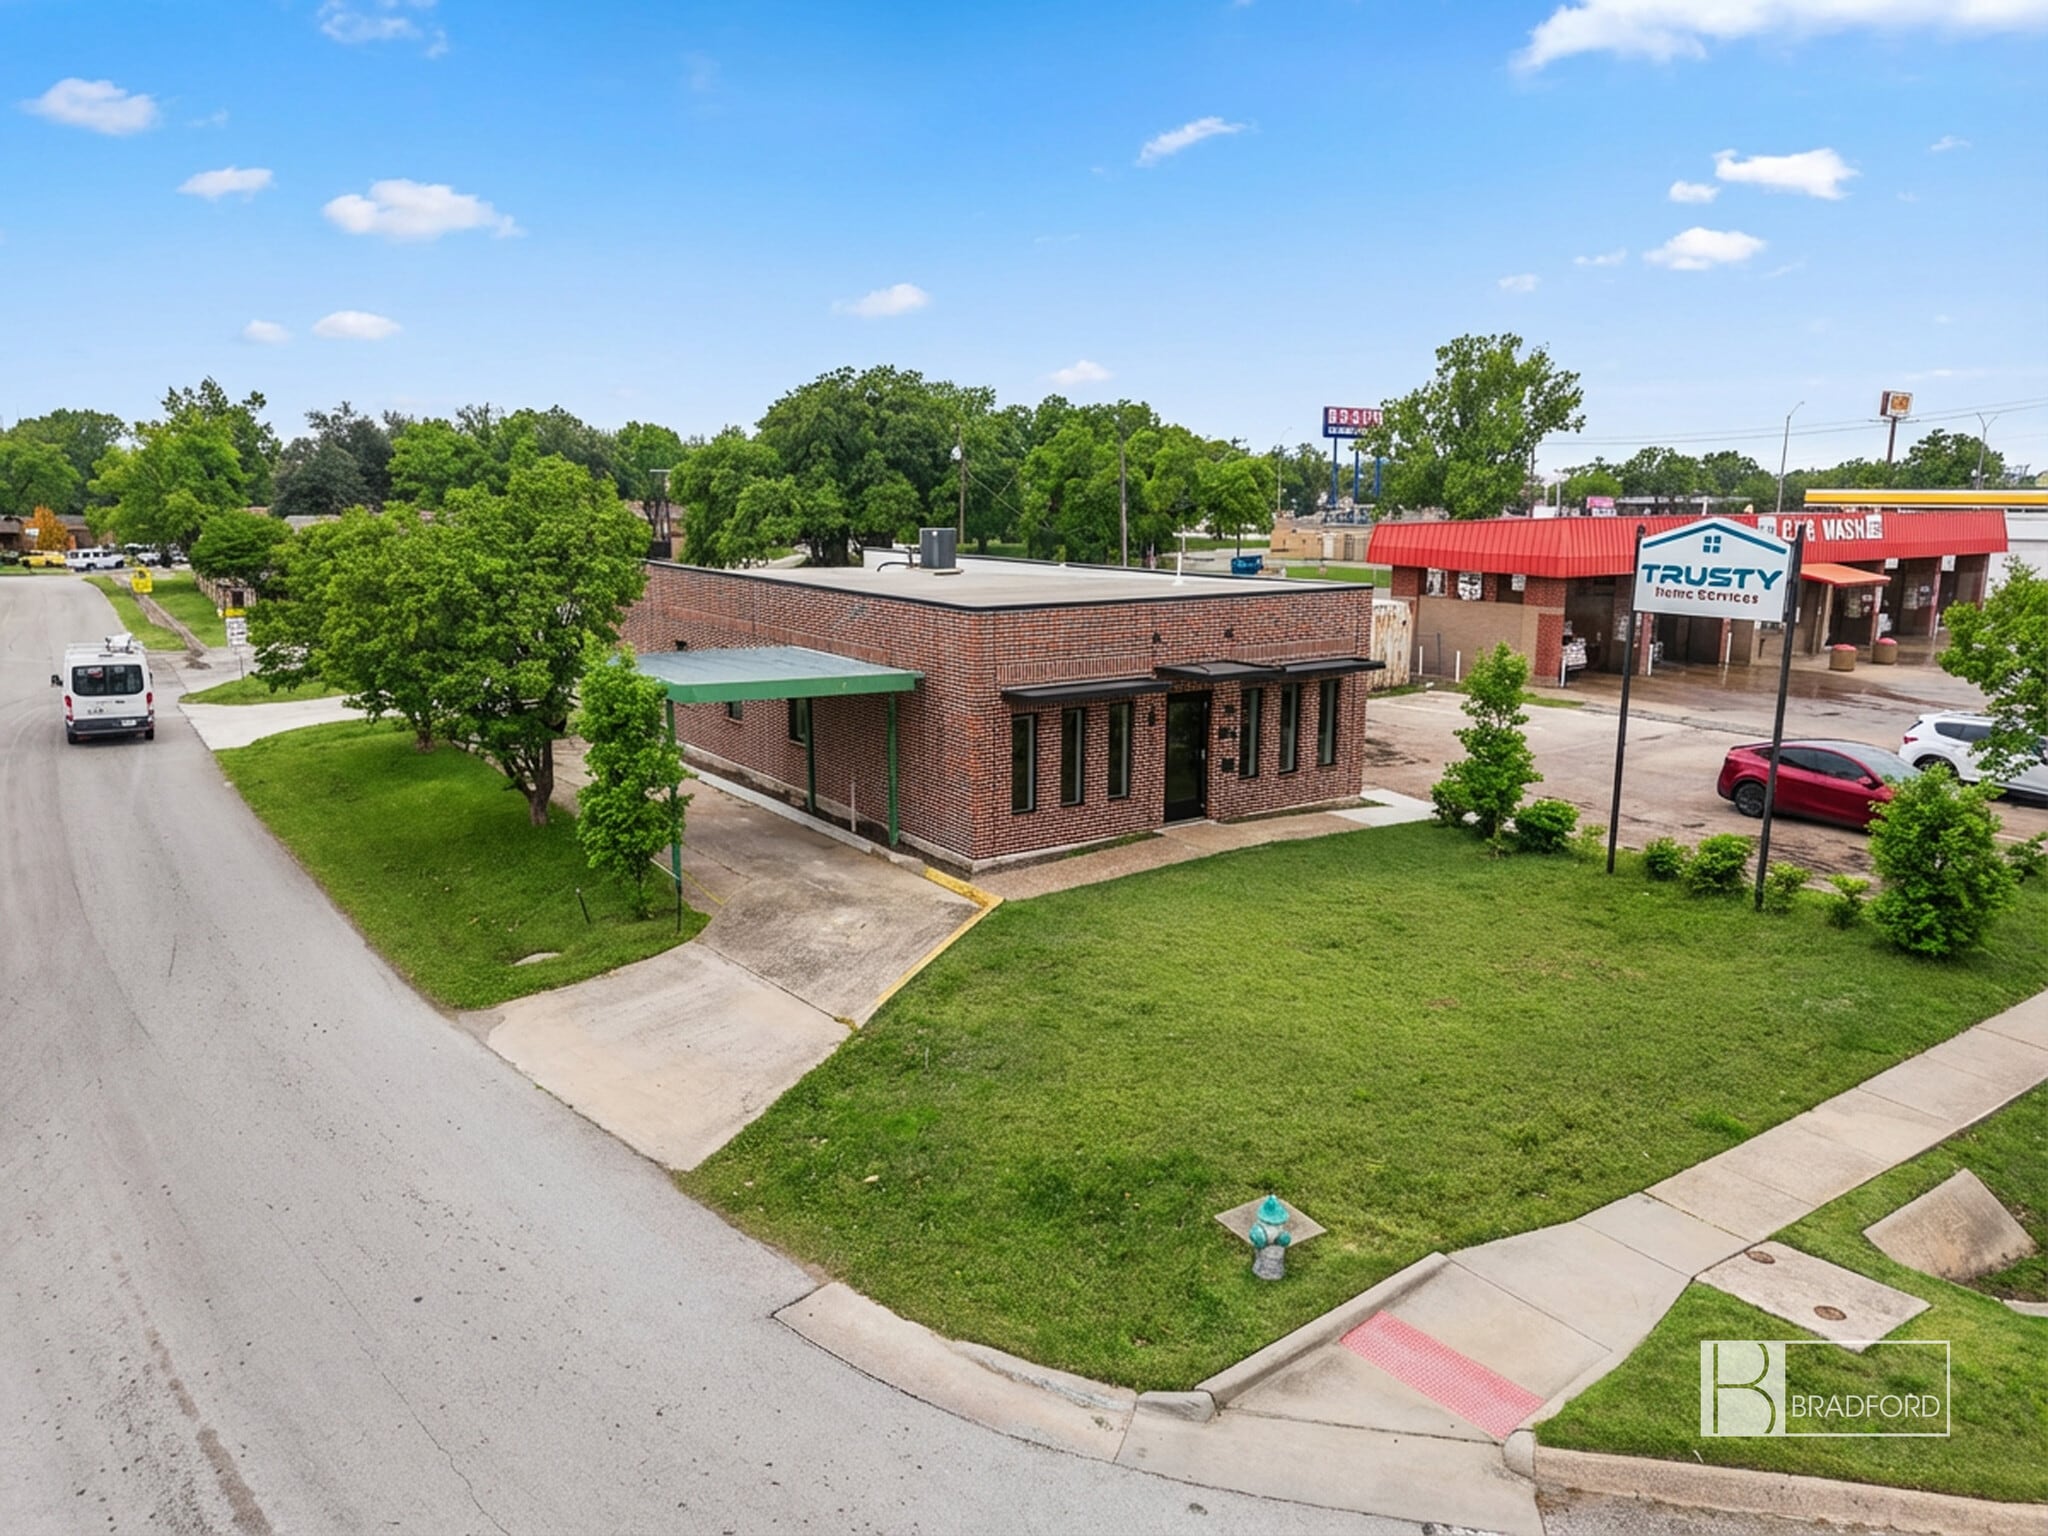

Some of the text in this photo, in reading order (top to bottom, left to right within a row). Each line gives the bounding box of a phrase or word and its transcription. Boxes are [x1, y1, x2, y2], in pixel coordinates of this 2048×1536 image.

[1822, 518, 1865, 541] WASH
[1641, 564, 1783, 590] TRUSTY
[1697, 589, 1759, 604] Services
